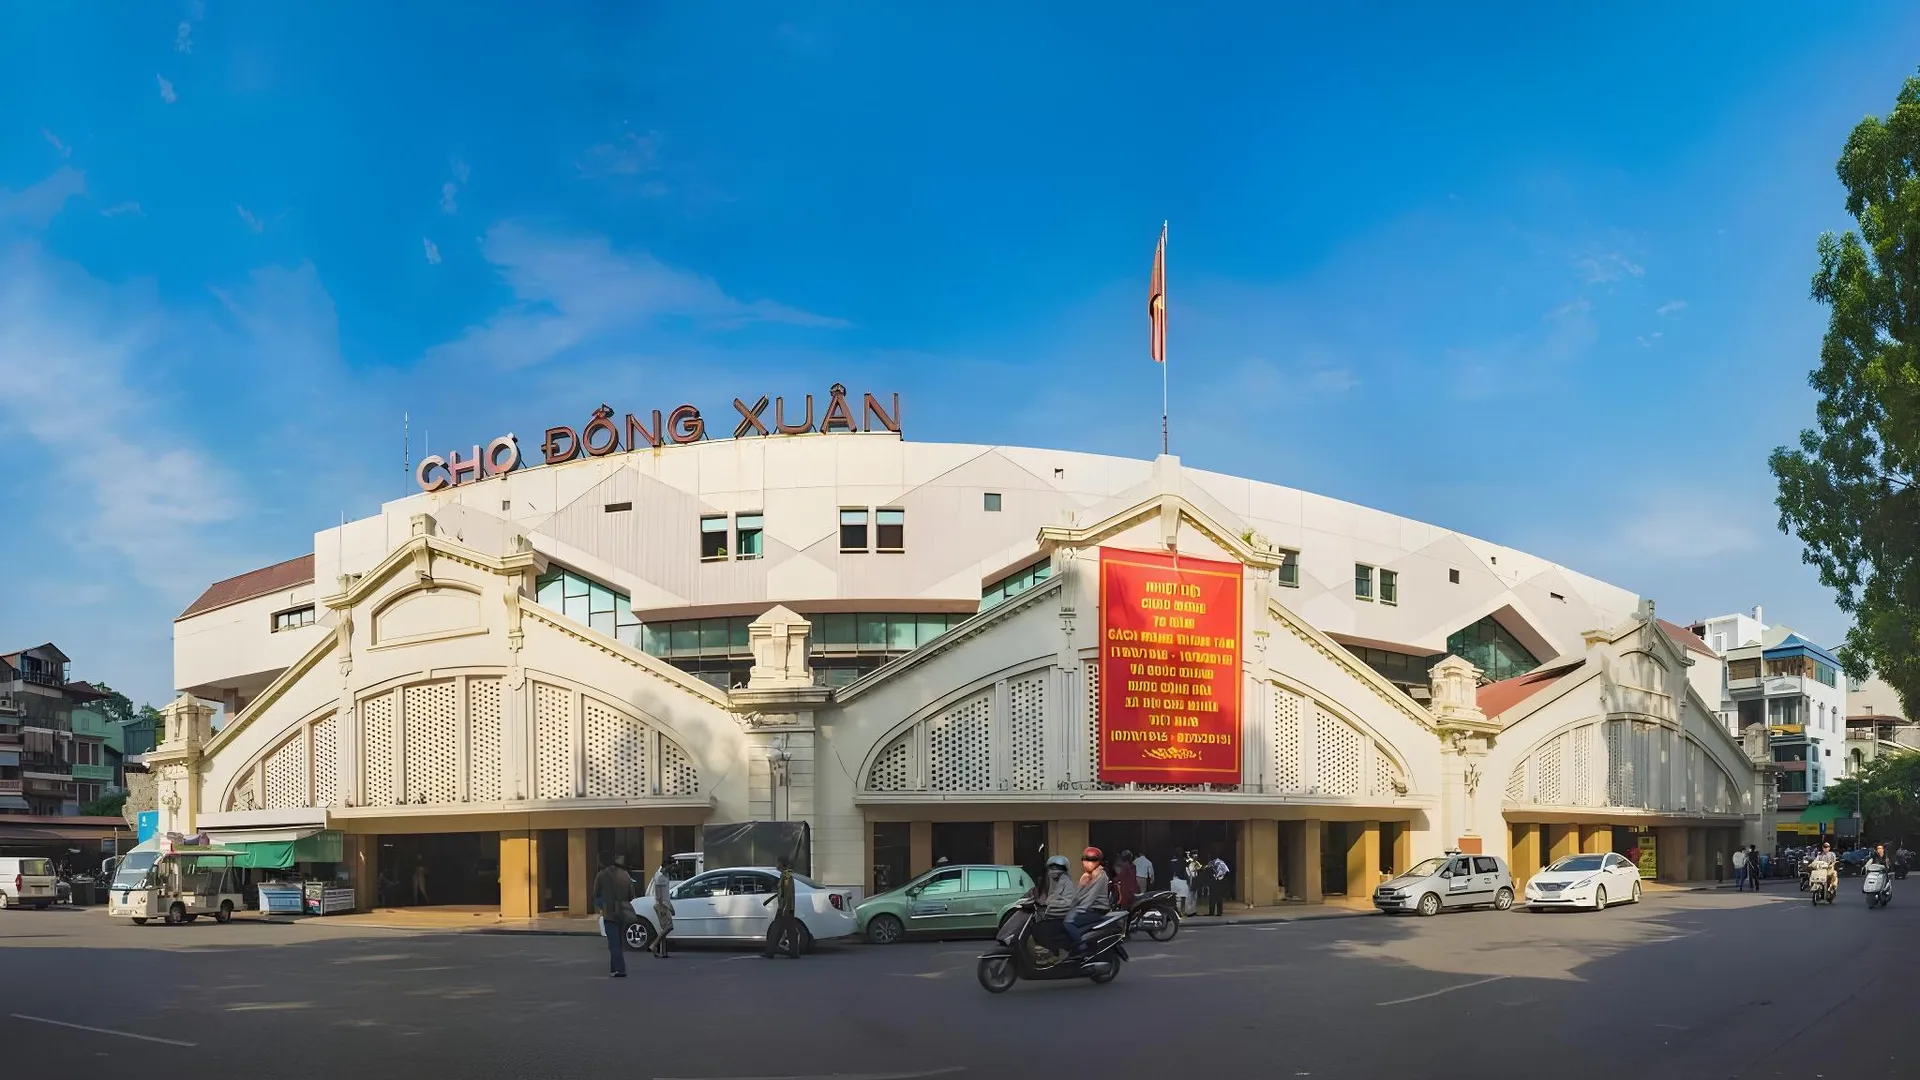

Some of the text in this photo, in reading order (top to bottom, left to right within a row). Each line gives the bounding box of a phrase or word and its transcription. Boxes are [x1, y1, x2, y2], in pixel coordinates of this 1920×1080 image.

[416, 383, 900, 491] CHỢ ĐỒNG XUÂN
